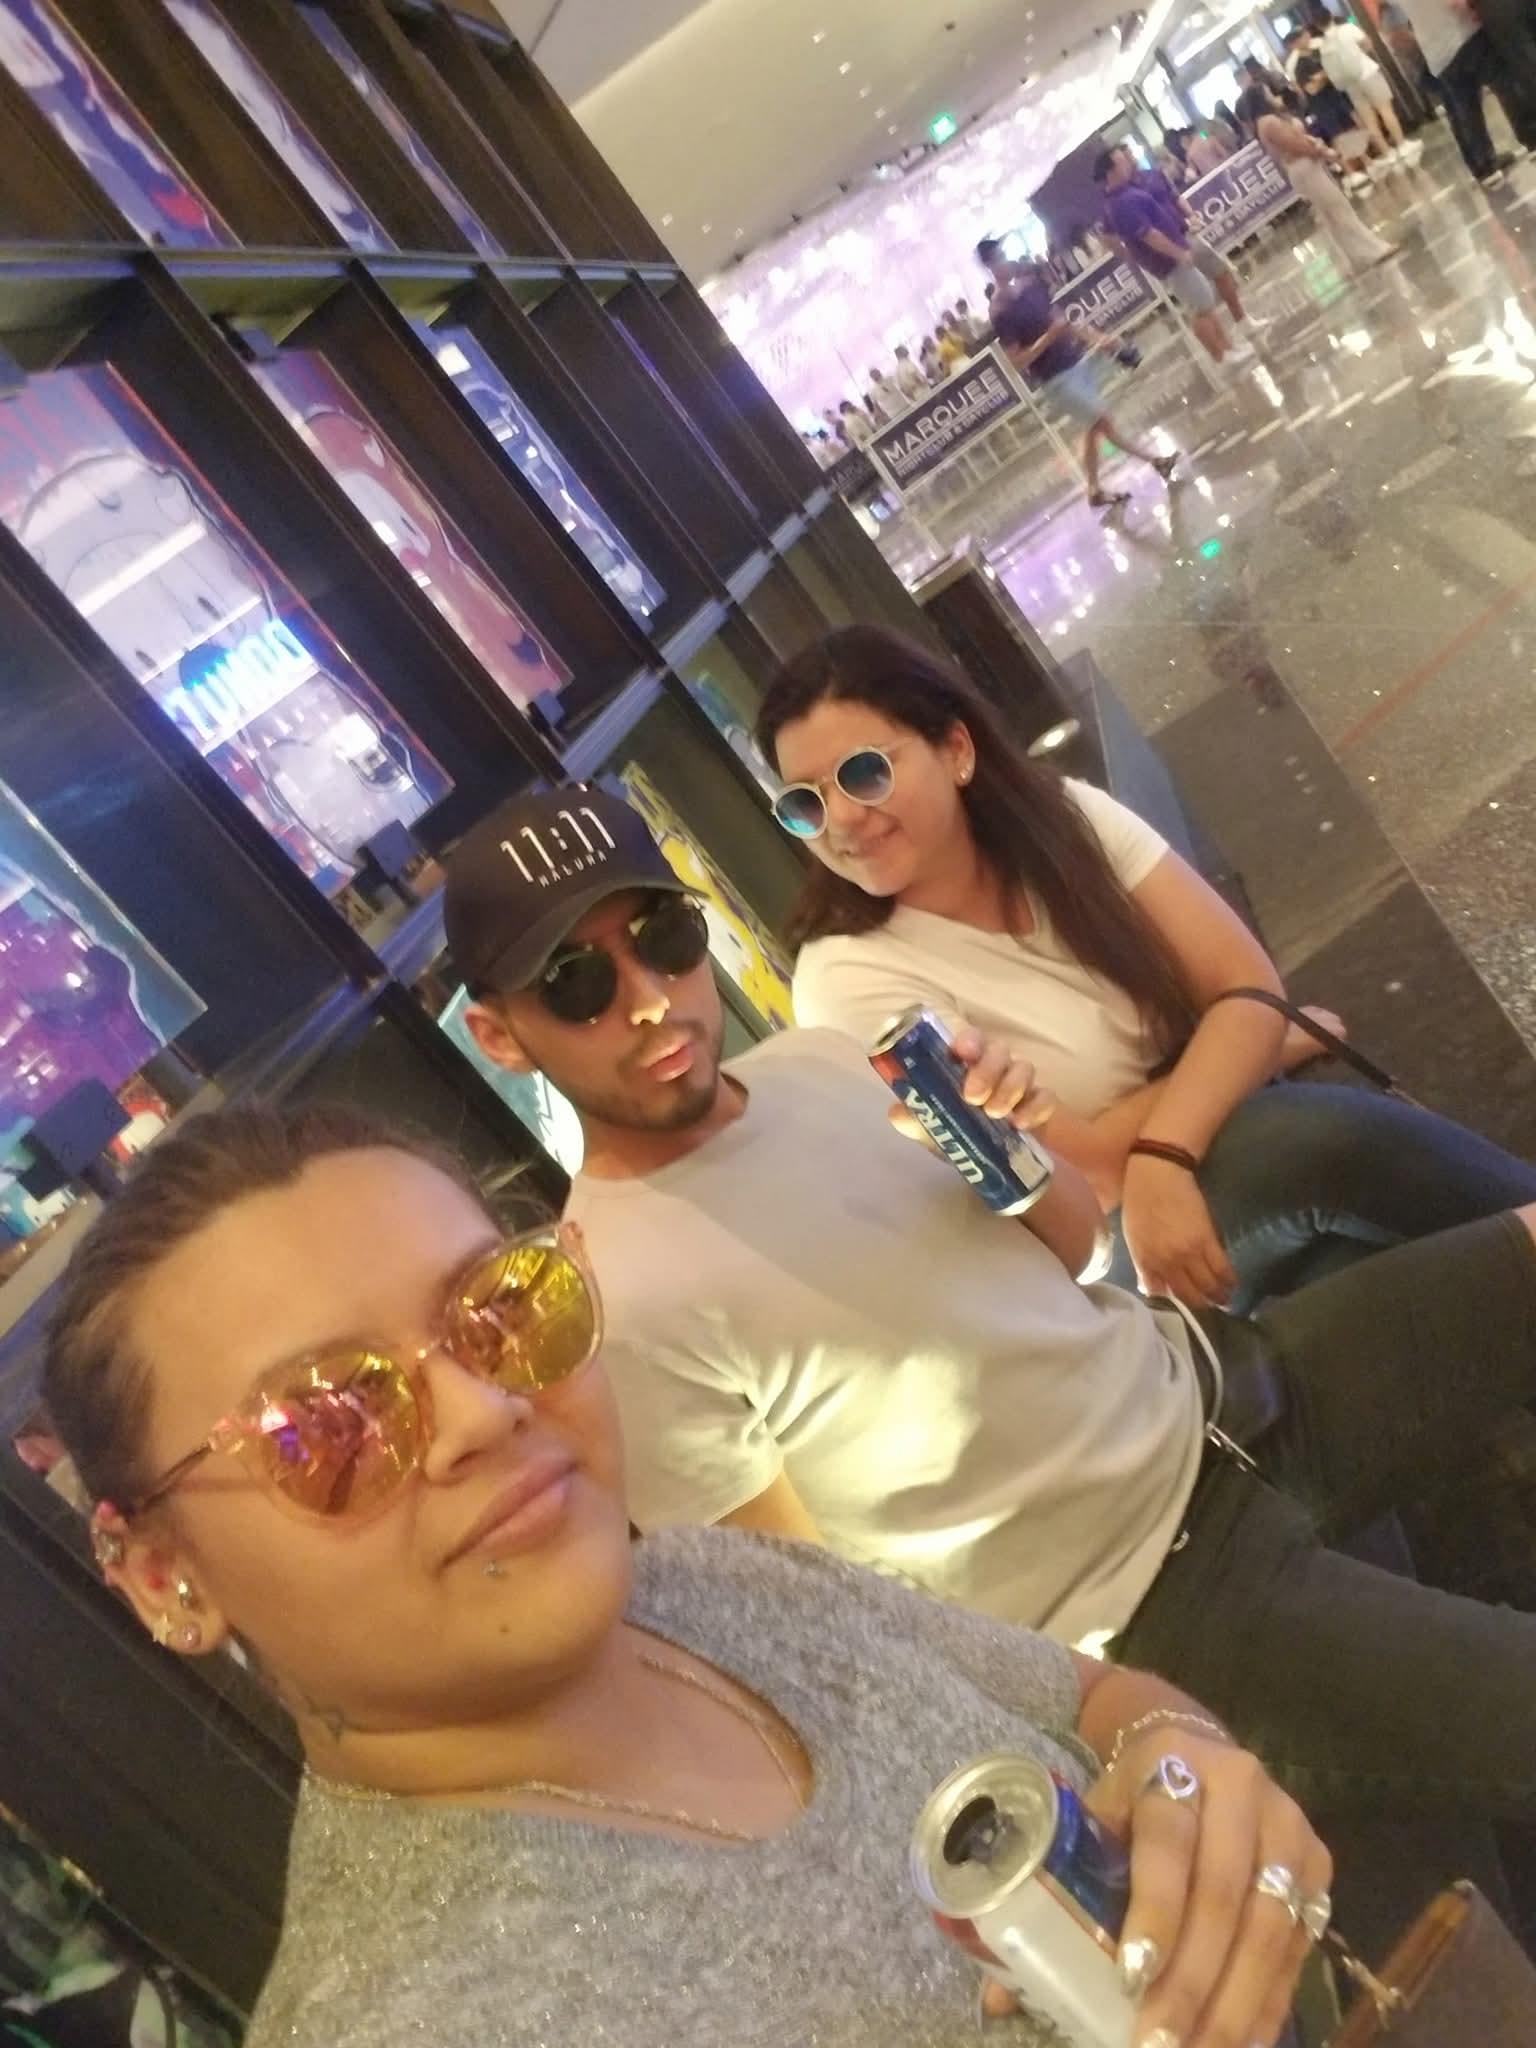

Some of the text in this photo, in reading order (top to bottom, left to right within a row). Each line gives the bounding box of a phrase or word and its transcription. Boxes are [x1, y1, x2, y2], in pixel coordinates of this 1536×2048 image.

[1064, 263, 1138, 327] QUEE
[882, 367, 1003, 467] MARQUEE
[895, 431, 955, 478] NIGHTCLUB
[961, 389, 1009, 428] DAYCLUB
[500, 807, 616, 883] 11:11
[538, 850, 608, 888] MALUMA
[904, 1085, 985, 1185] ULTRA
